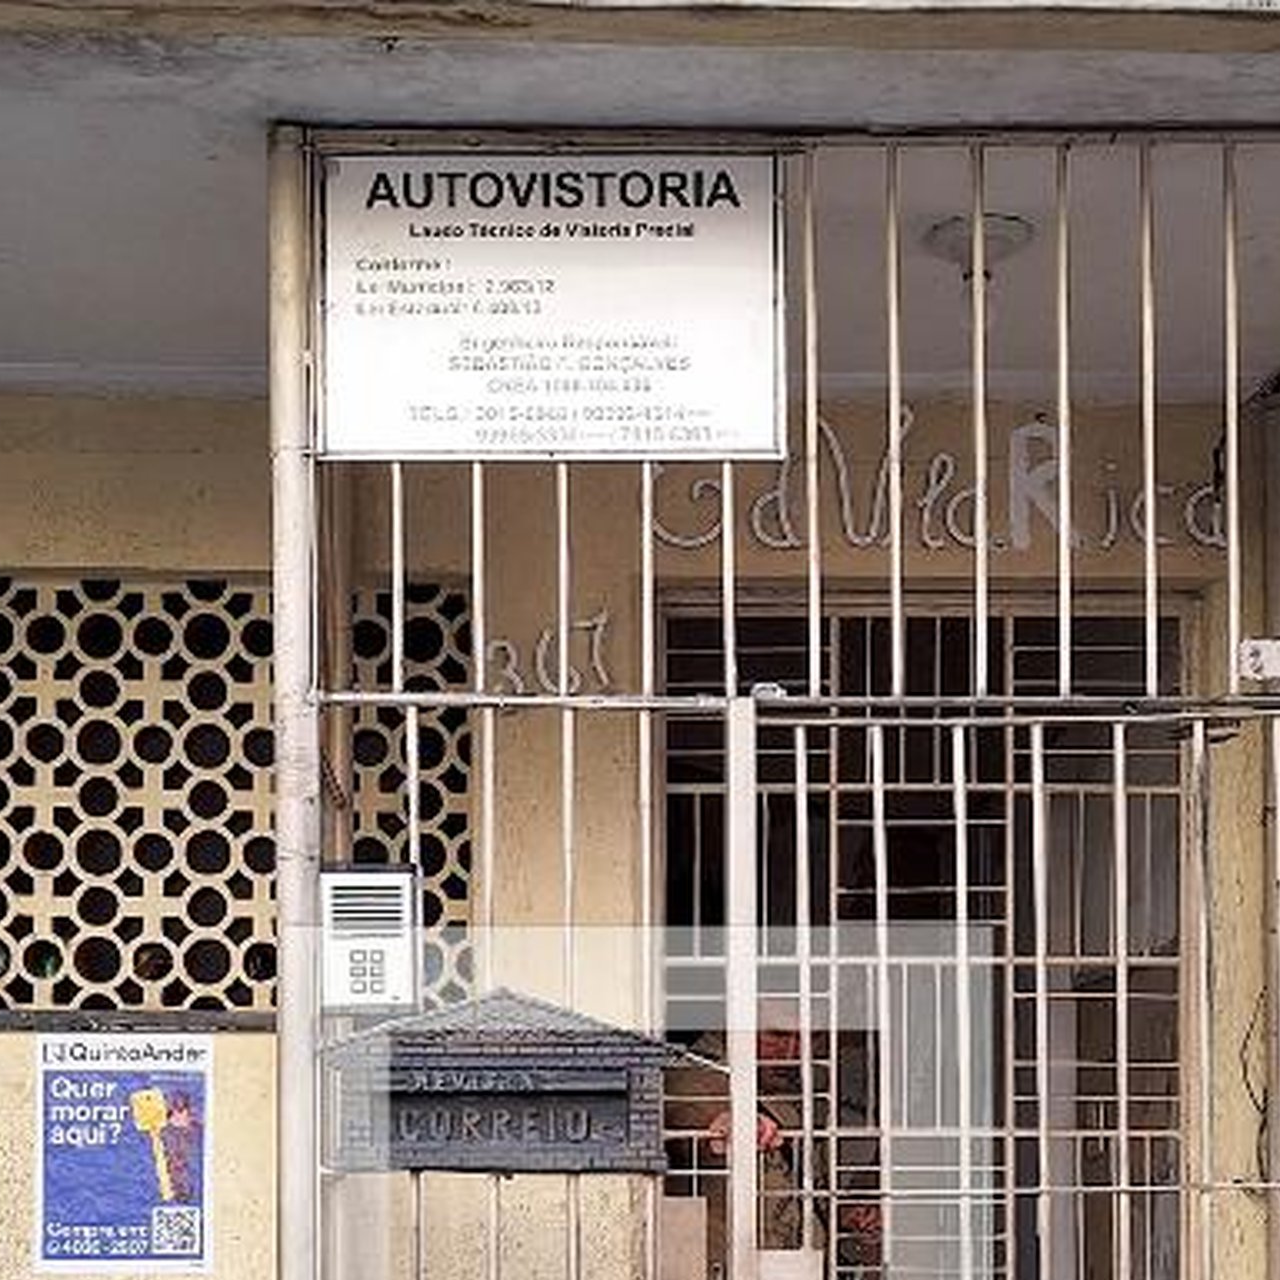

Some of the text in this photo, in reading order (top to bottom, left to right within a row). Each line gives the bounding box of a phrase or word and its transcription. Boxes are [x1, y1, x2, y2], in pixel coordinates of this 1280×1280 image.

[366, 170, 741, 209] AUTOVISTORIA
[52, 1078, 117, 1098] Quer
[51, 1103, 129, 1121] morar
[50, 1125, 122, 1146] aqui?
[400, 1108, 589, 1143] CORREIO
